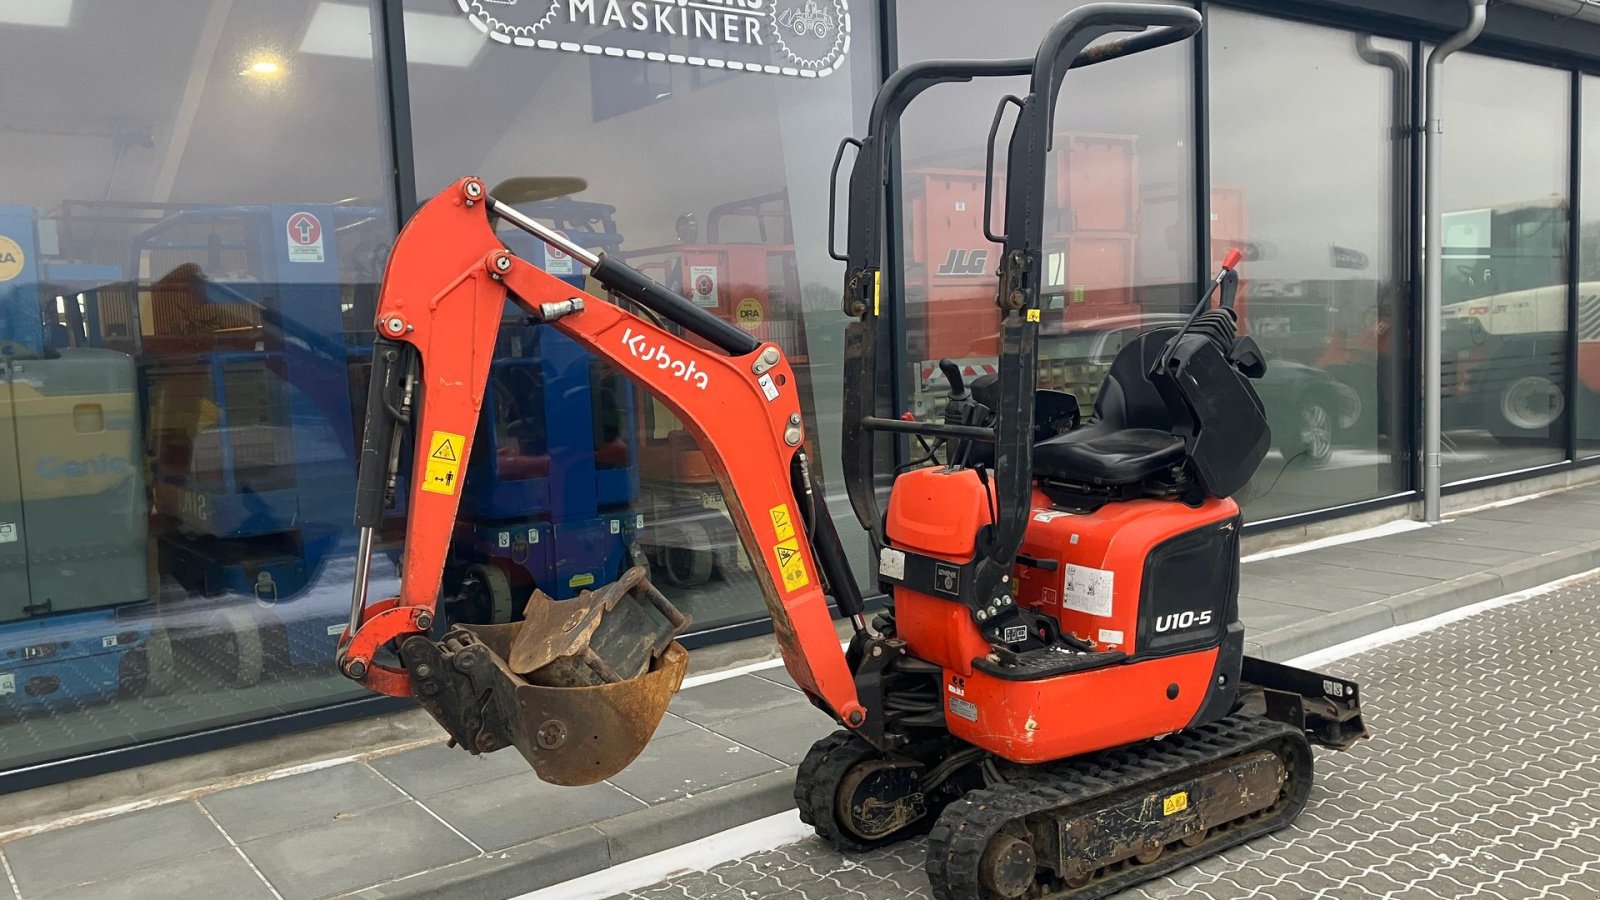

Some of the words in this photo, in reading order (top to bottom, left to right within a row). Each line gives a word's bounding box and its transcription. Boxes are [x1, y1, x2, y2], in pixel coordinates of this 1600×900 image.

[569, 0, 764, 45] MASKINER
[937, 249, 989, 275] JLG
[740, 310, 760, 318] DRA
[621, 327, 709, 390] Kubota
[1155, 610, 1212, 633] U10-5
